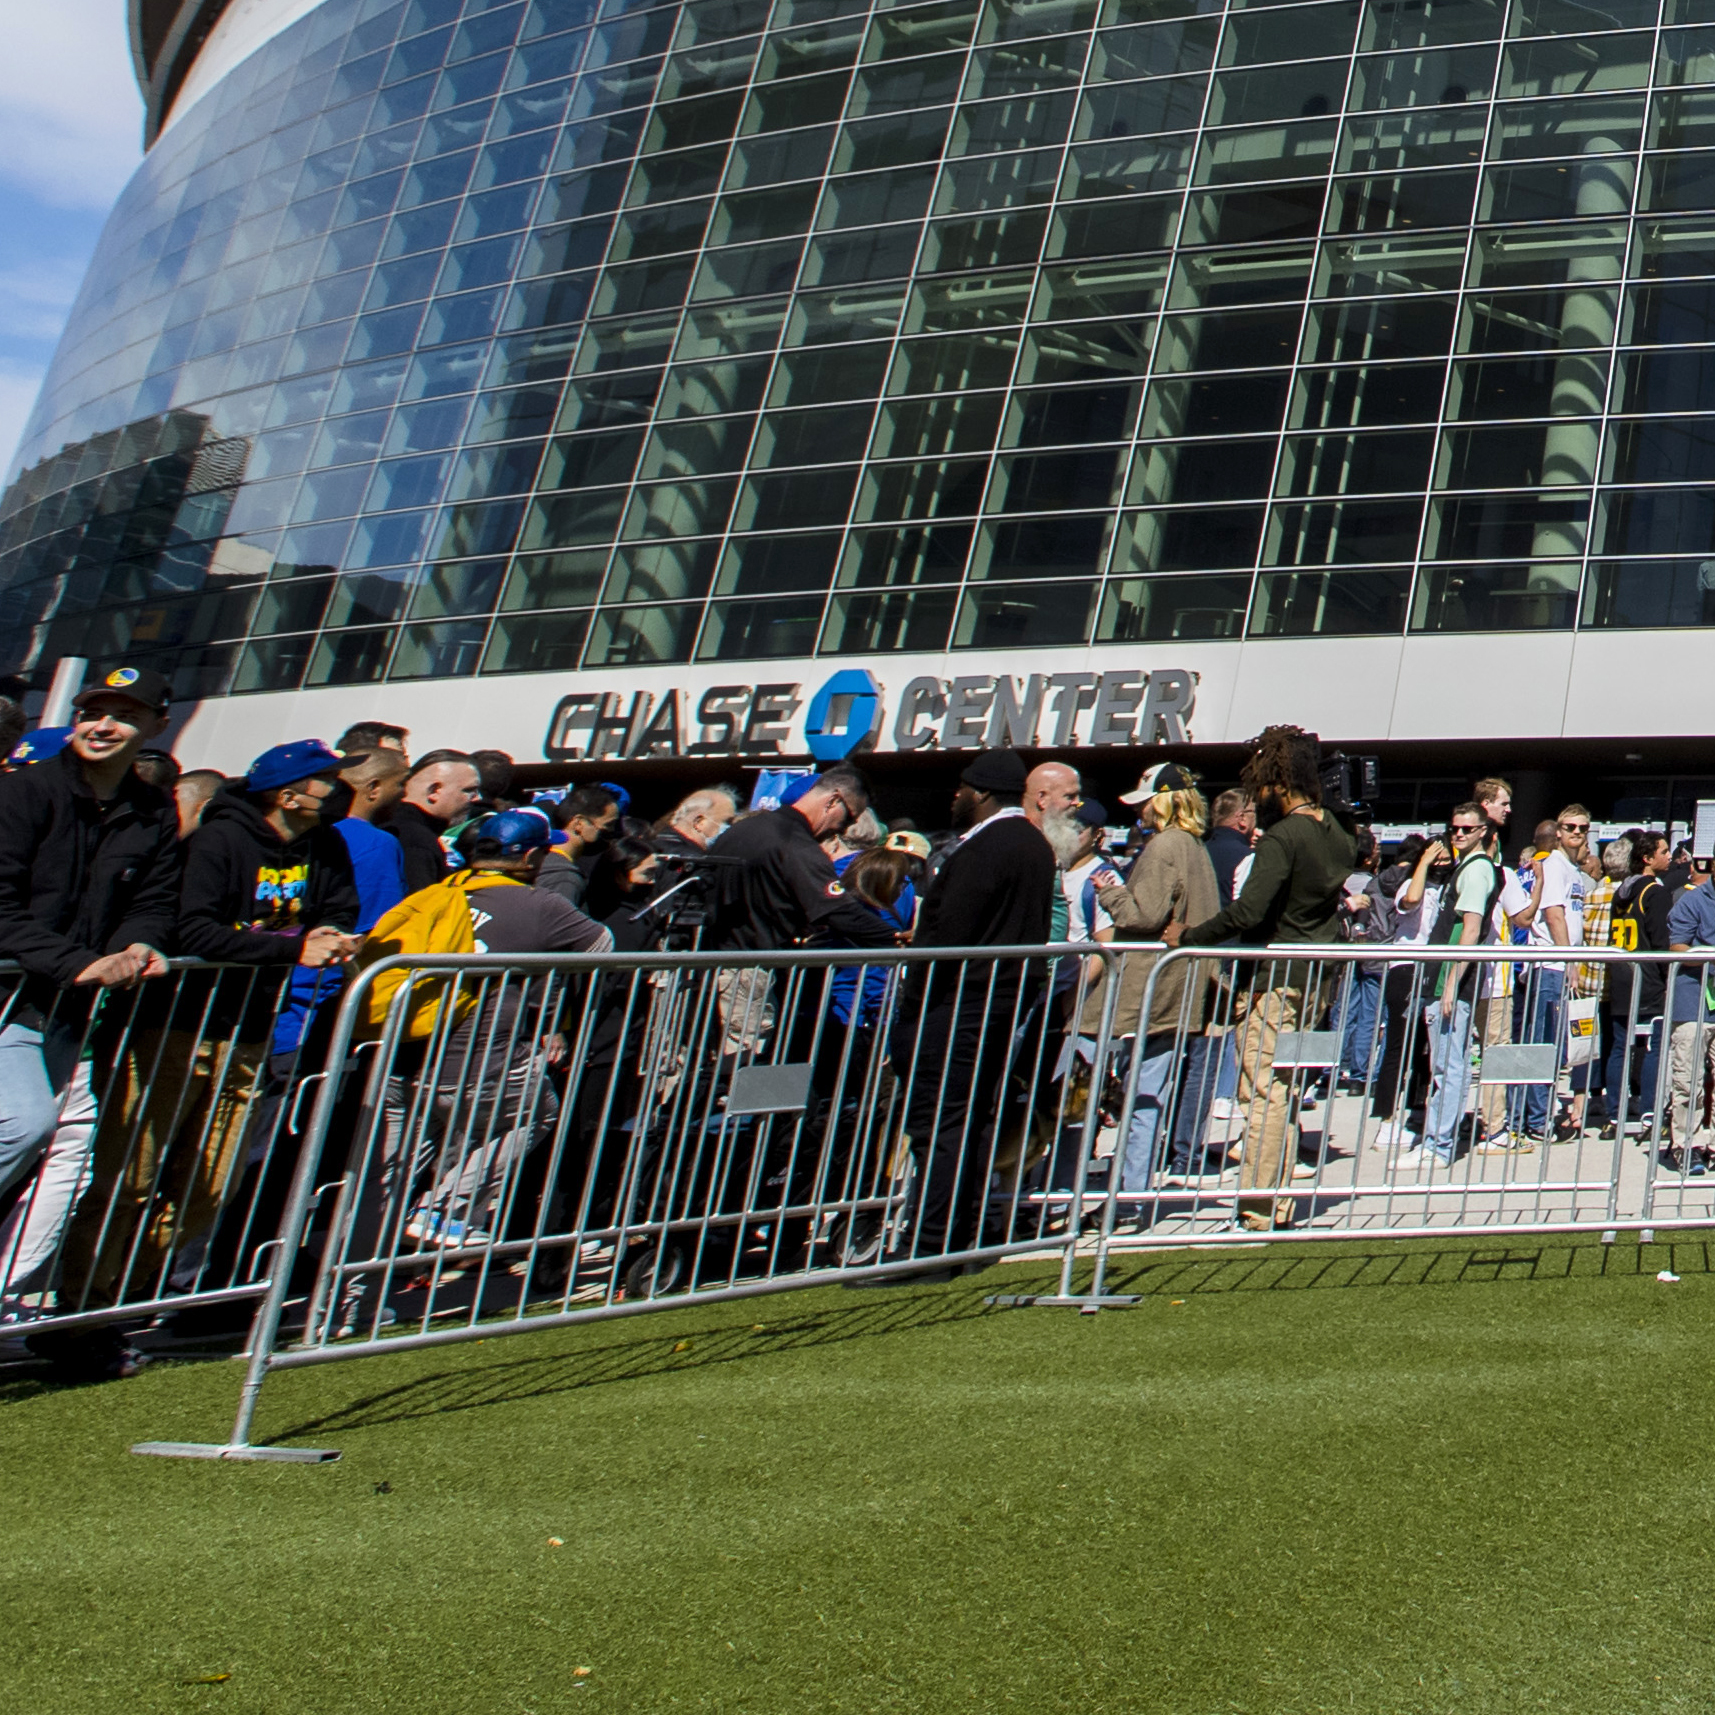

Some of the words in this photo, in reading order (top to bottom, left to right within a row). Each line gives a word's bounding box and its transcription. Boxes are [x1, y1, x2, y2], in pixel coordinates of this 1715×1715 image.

[542, 682, 805, 760] CHASE
[893, 669, 1200, 750] CENTER
[1611, 918, 1638, 952] 30
